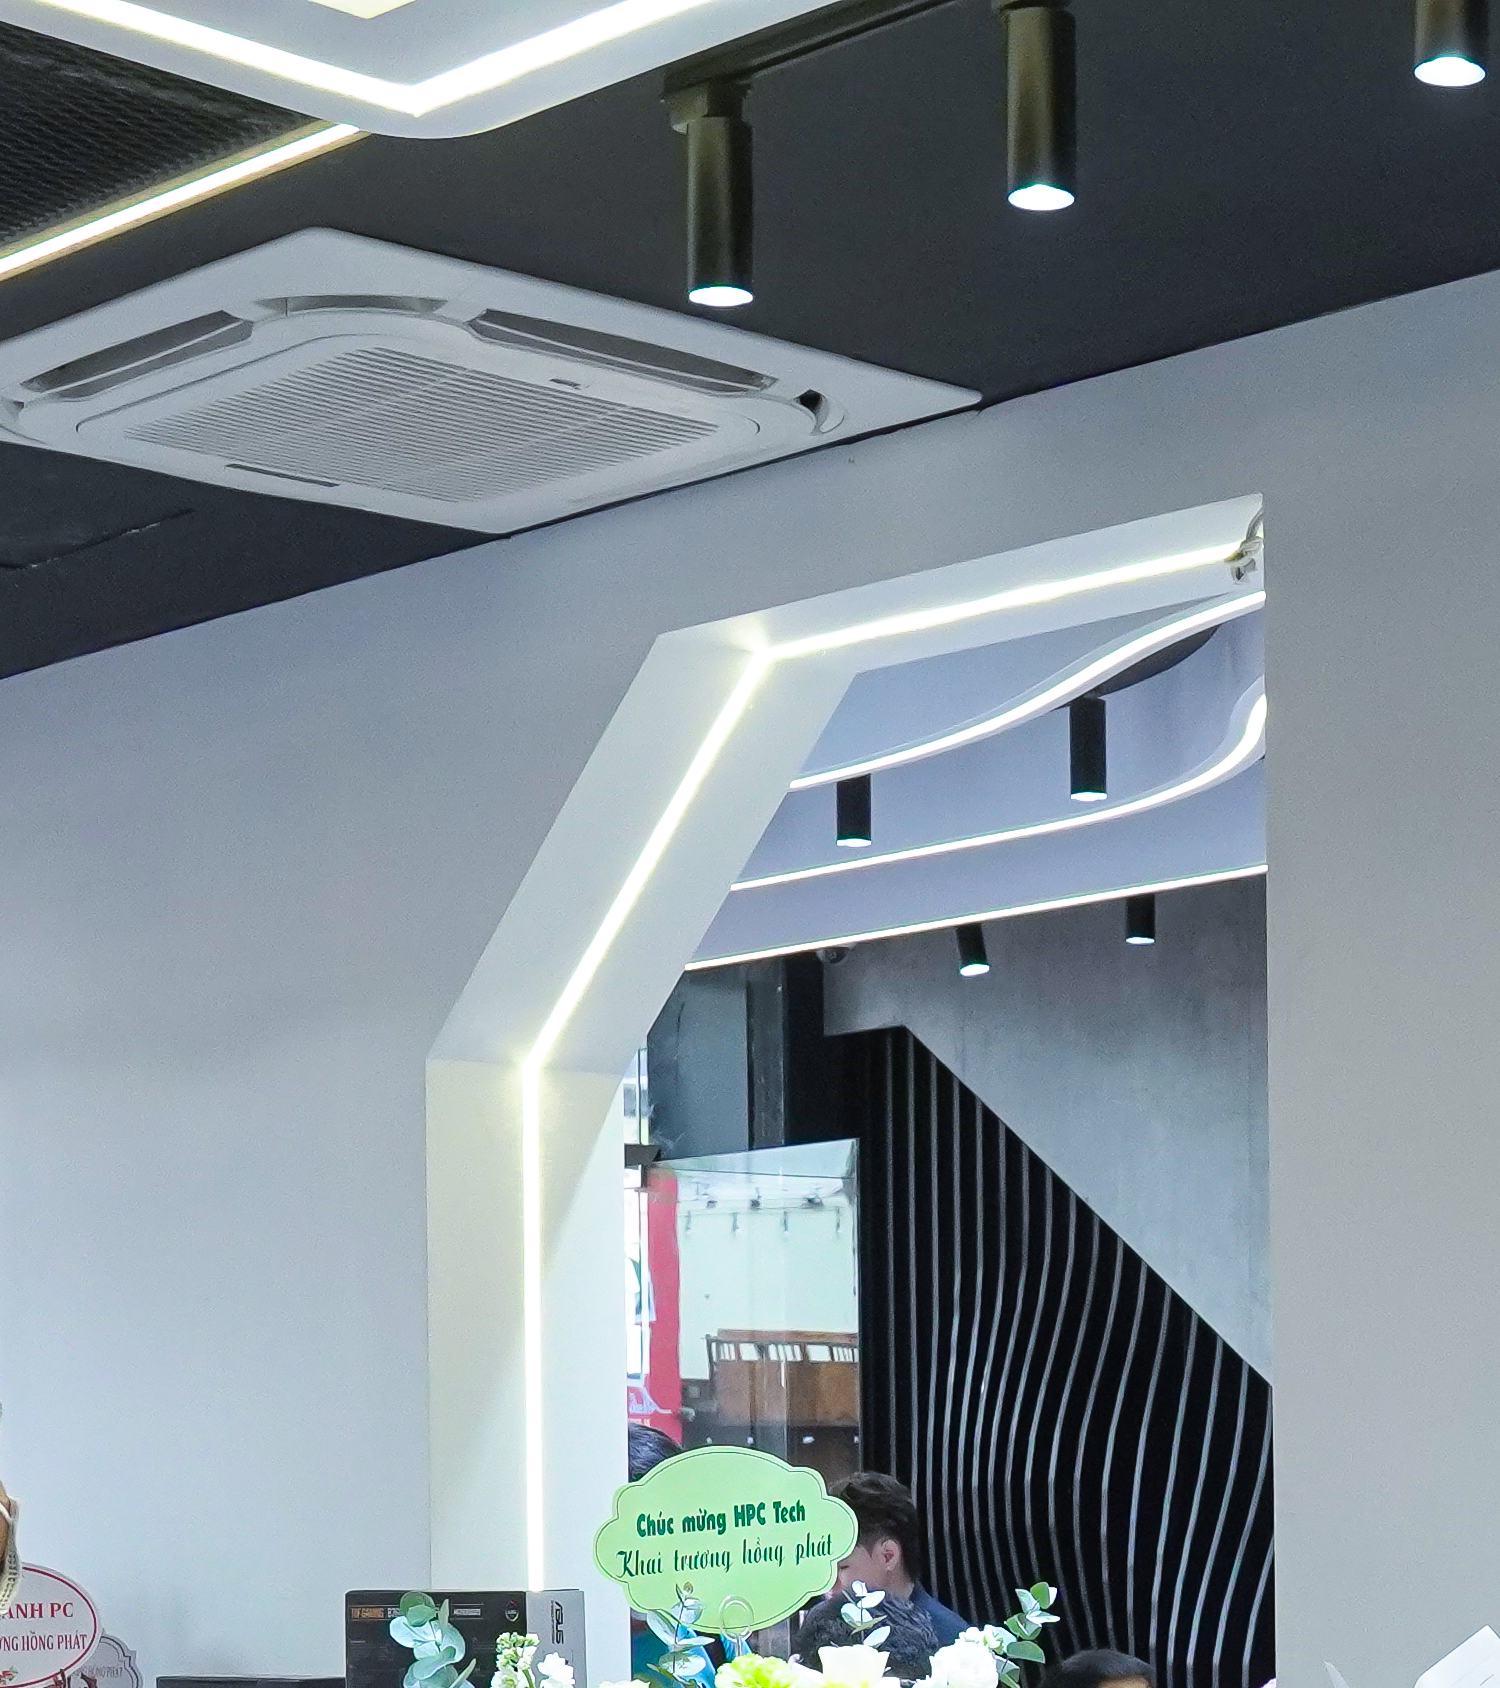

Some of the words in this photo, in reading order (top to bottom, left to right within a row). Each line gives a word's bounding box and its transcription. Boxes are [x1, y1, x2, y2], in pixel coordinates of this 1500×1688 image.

[637, 1511, 674, 1537] Chúc
[682, 1508, 727, 1535] mừng
[734, 1501, 766, 1528] HPC
[773, 1499, 806, 1524] Tech
[615, 1550, 663, 1578] Khai
[795, 1532, 833, 1566] phát
[50, 1602, 74, 1618] PC
